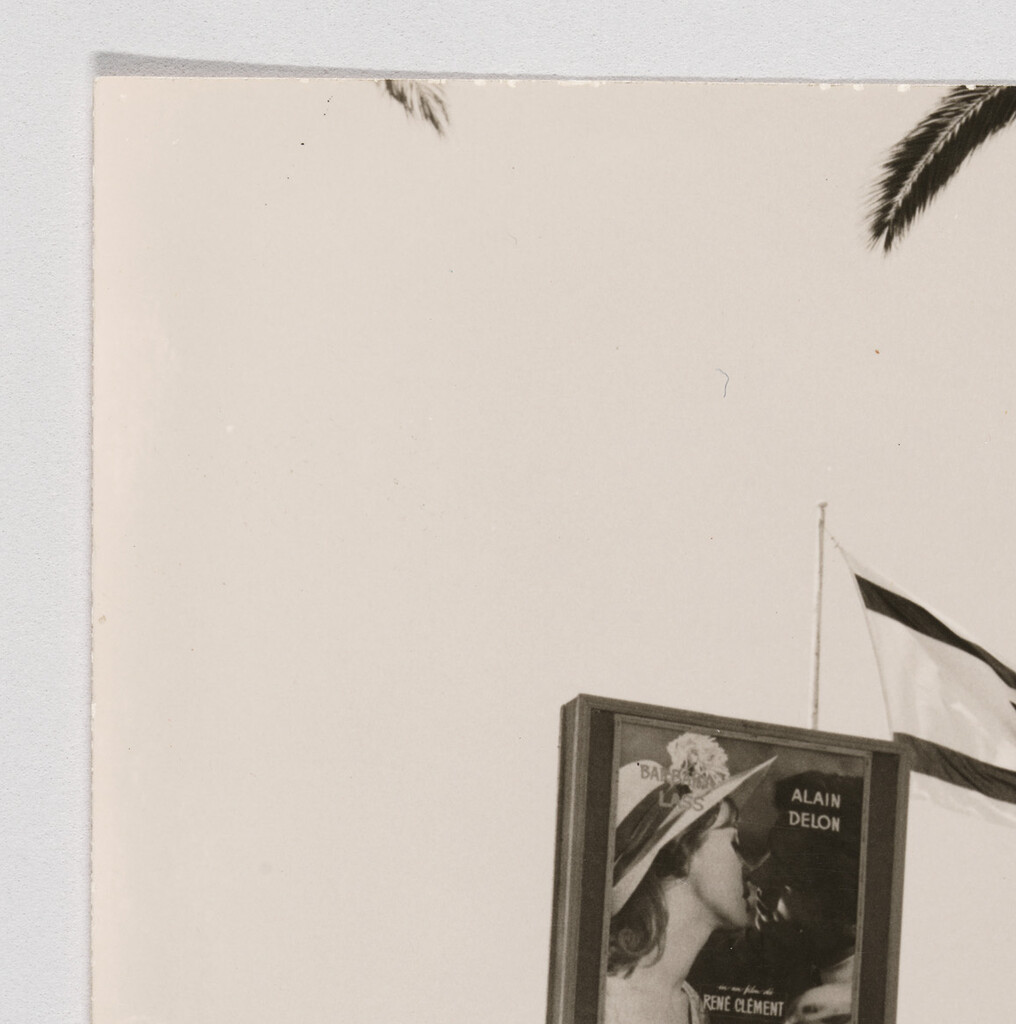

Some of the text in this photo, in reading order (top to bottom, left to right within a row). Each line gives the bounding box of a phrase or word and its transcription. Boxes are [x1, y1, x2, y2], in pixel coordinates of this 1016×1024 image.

[658, 790, 704, 811] LASS
[791, 787, 841, 809] ALAIN
[788, 811, 841, 832] DELON
